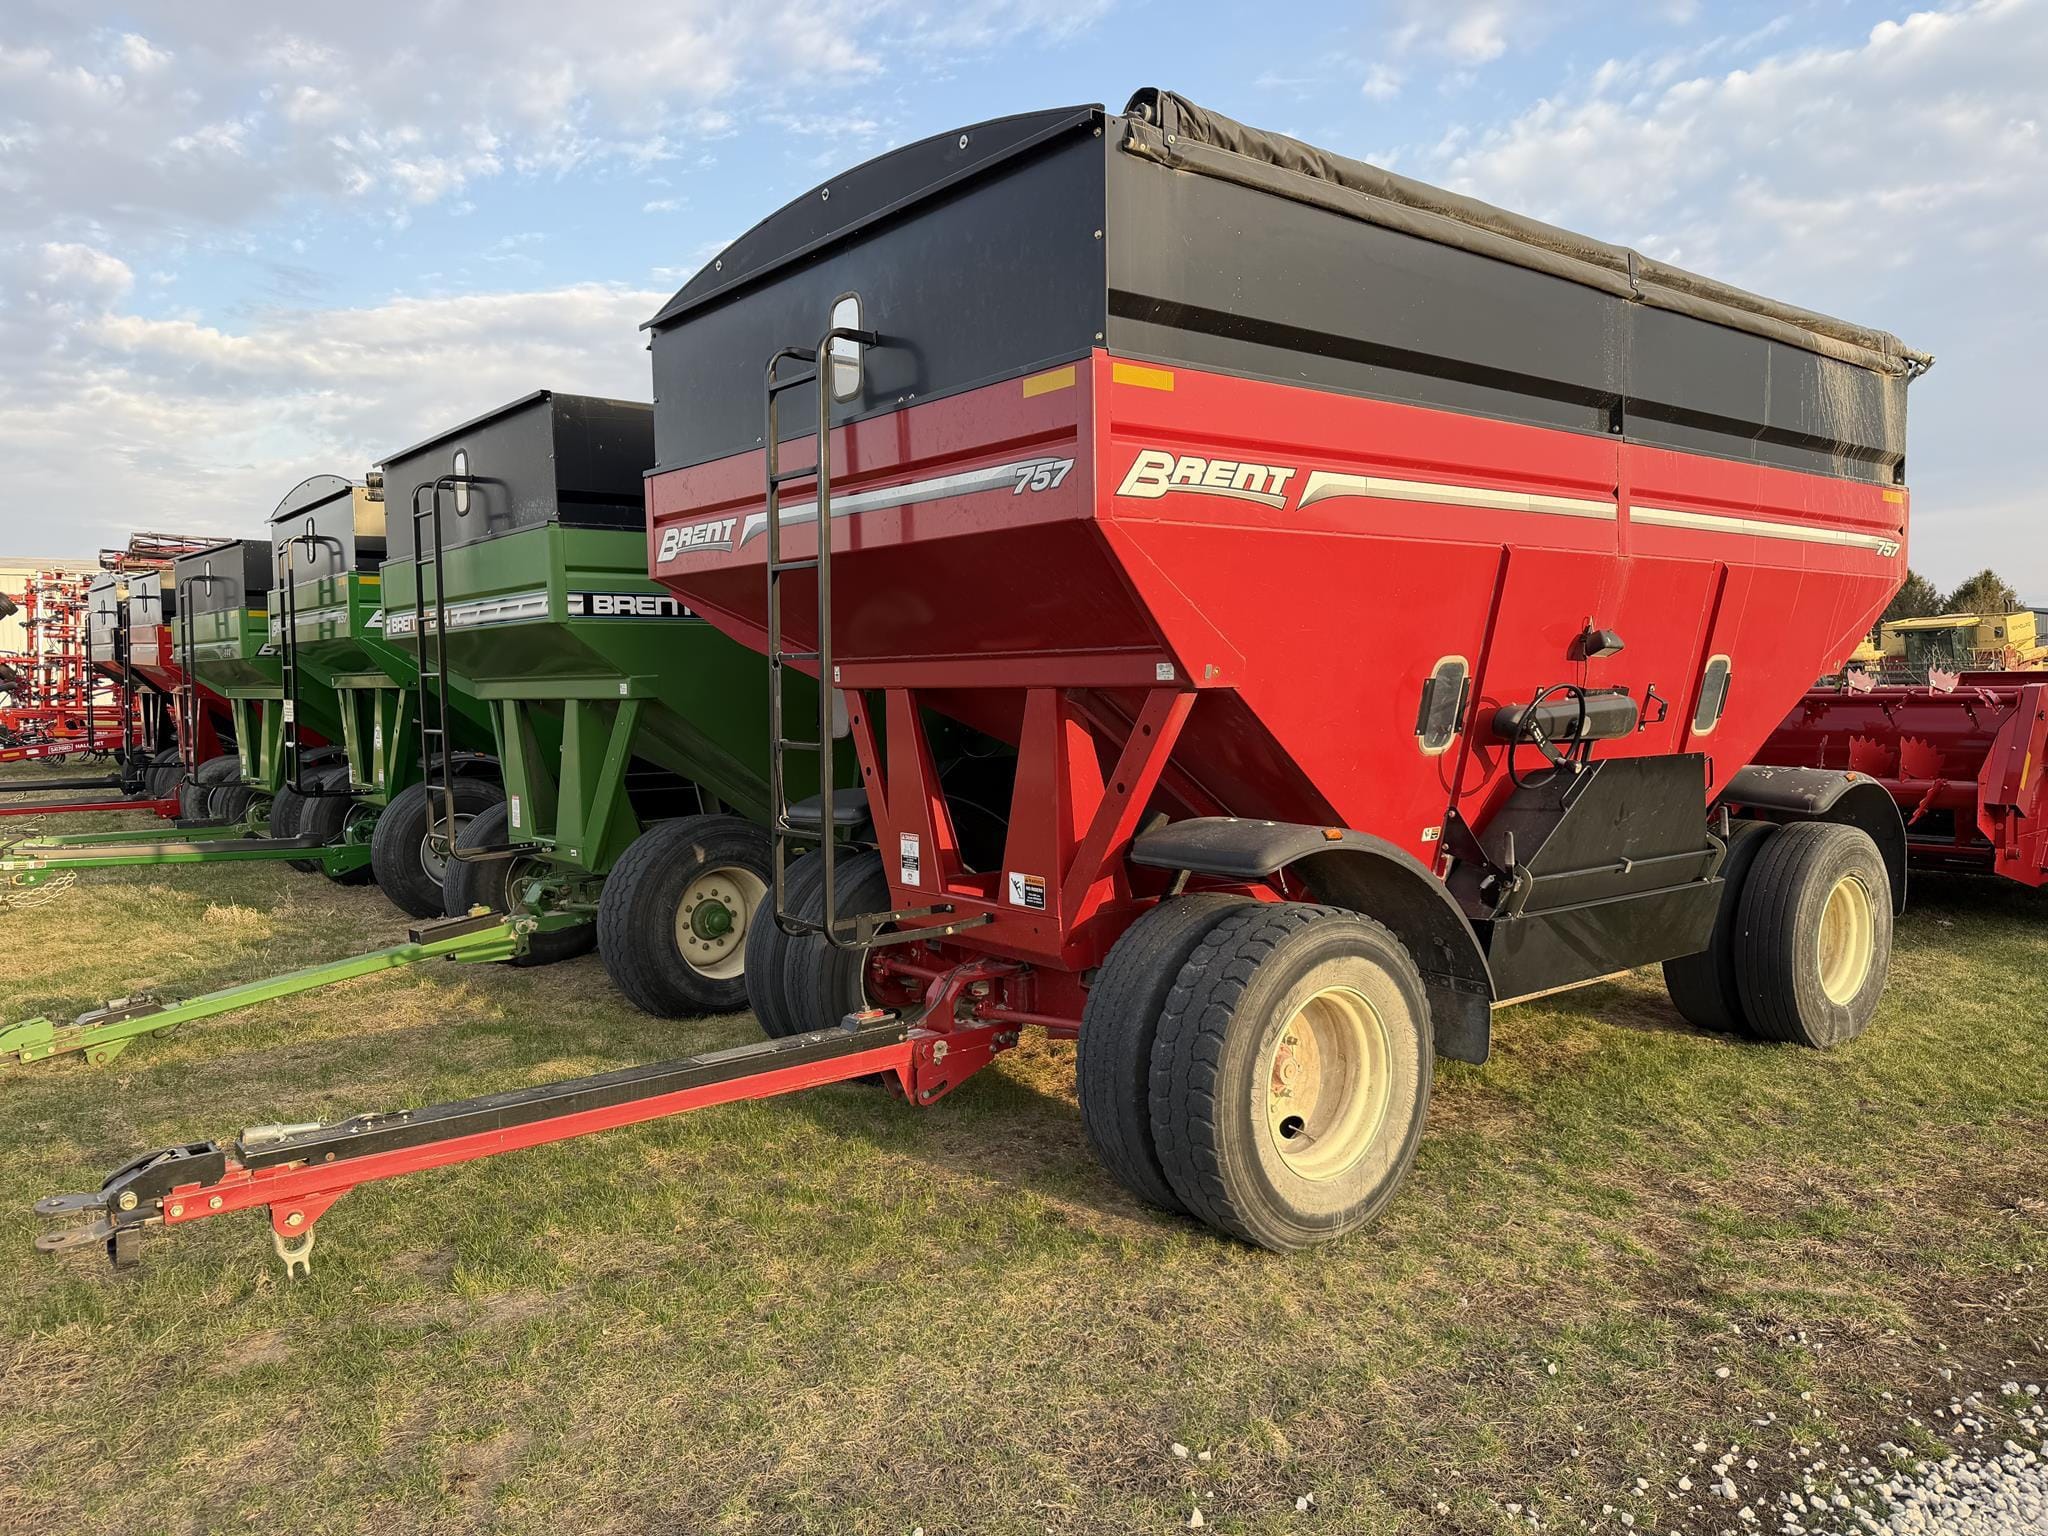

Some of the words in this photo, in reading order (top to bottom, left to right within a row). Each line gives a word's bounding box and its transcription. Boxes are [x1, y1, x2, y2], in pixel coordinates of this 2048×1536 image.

[1012, 457, 1076, 496] 757
[1114, 448, 1297, 499] BRENT
[656, 517, 738, 563] BRENT
[1876, 540, 1901, 558] 757
[391, 613, 418, 634] BREN
